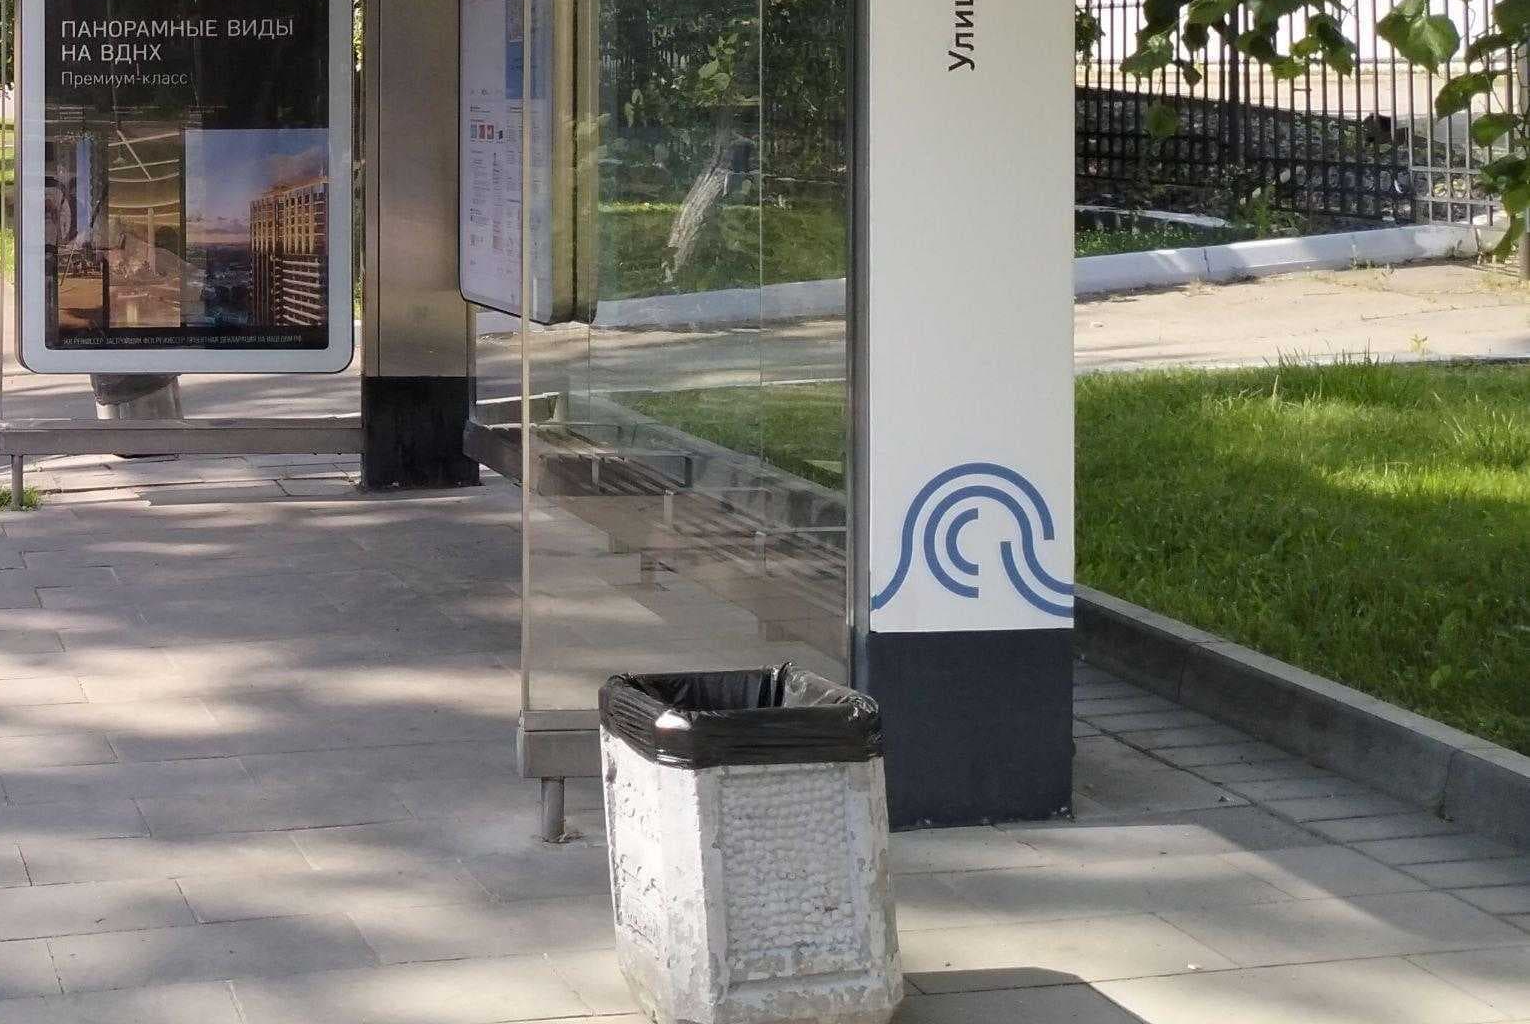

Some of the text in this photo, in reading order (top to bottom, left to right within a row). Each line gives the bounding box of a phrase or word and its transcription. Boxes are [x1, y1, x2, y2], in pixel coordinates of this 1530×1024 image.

[60, 18, 295, 41] ПАНОРАМНЫЕ ВИДЫ
[60, 43, 163, 65] НА ВДНХ
[60, 70, 189, 89] Премиум-класс
